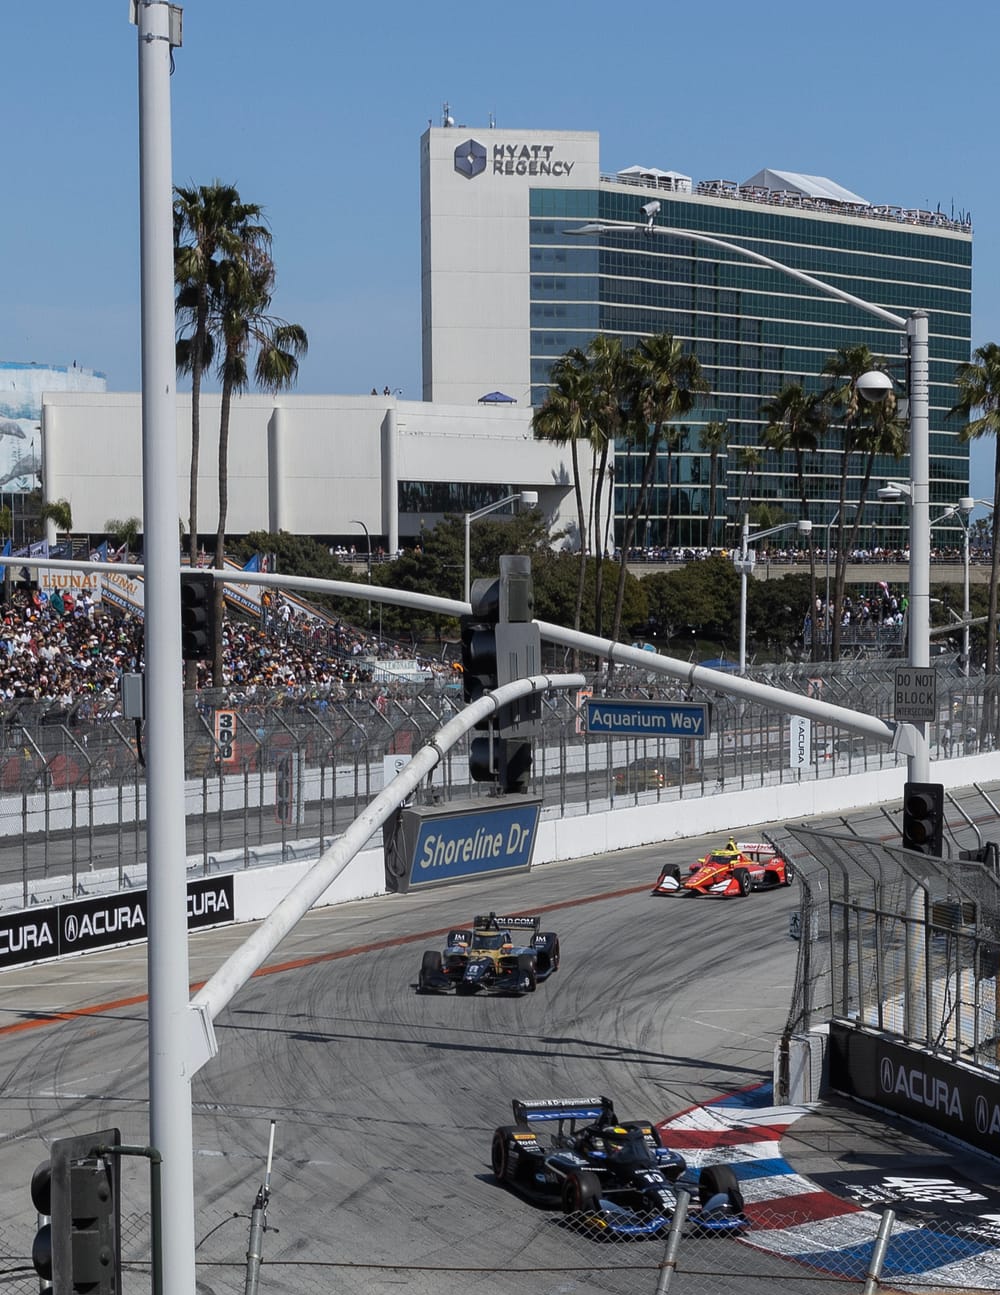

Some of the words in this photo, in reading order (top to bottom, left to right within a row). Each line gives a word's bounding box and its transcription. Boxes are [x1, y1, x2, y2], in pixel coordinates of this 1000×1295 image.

[493, 143, 554, 161] HYATT
[492, 160, 575, 176] REGENCY
[42, 574, 98, 588] LiUNA!
[897, 674, 911, 687] DO
[915, 674, 934, 687] NOT
[896, 691, 934, 705] BLOCK
[591, 709, 666, 730] Aquarium
[670, 712, 702, 733] Way
[420, 827, 503, 869] Shoreline
[506, 822, 530, 855] Dr
[78, 904, 146, 938] ACURA
[894, 1065, 964, 1121] ACURA
[644, 1173, 664, 1183] 10
